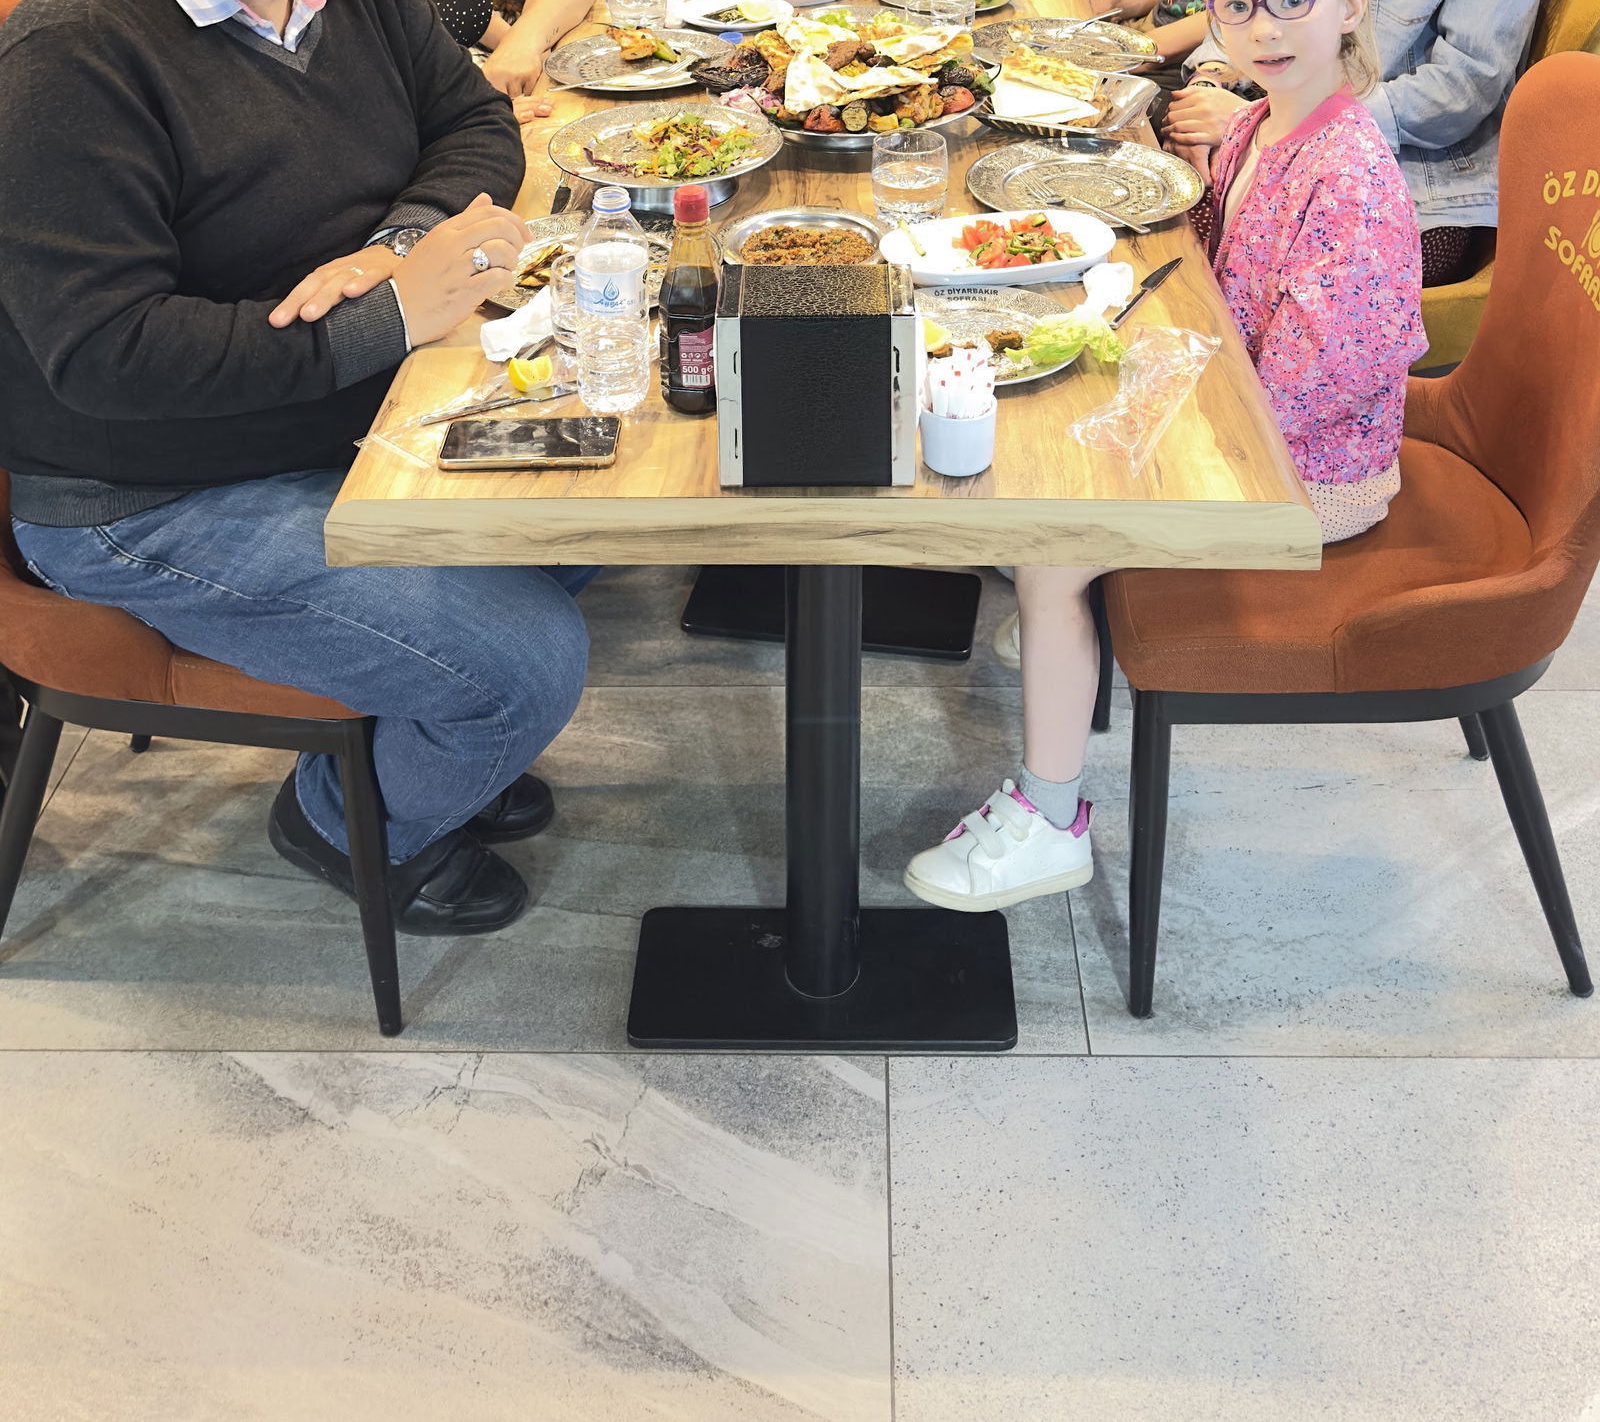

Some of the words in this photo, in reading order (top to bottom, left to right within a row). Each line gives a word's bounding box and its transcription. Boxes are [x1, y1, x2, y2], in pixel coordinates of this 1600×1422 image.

[1543, 170, 1577, 205] ÖZ
[947, 288, 999, 296] DİYARBAKIR
[682, 365, 699, 374] 500
